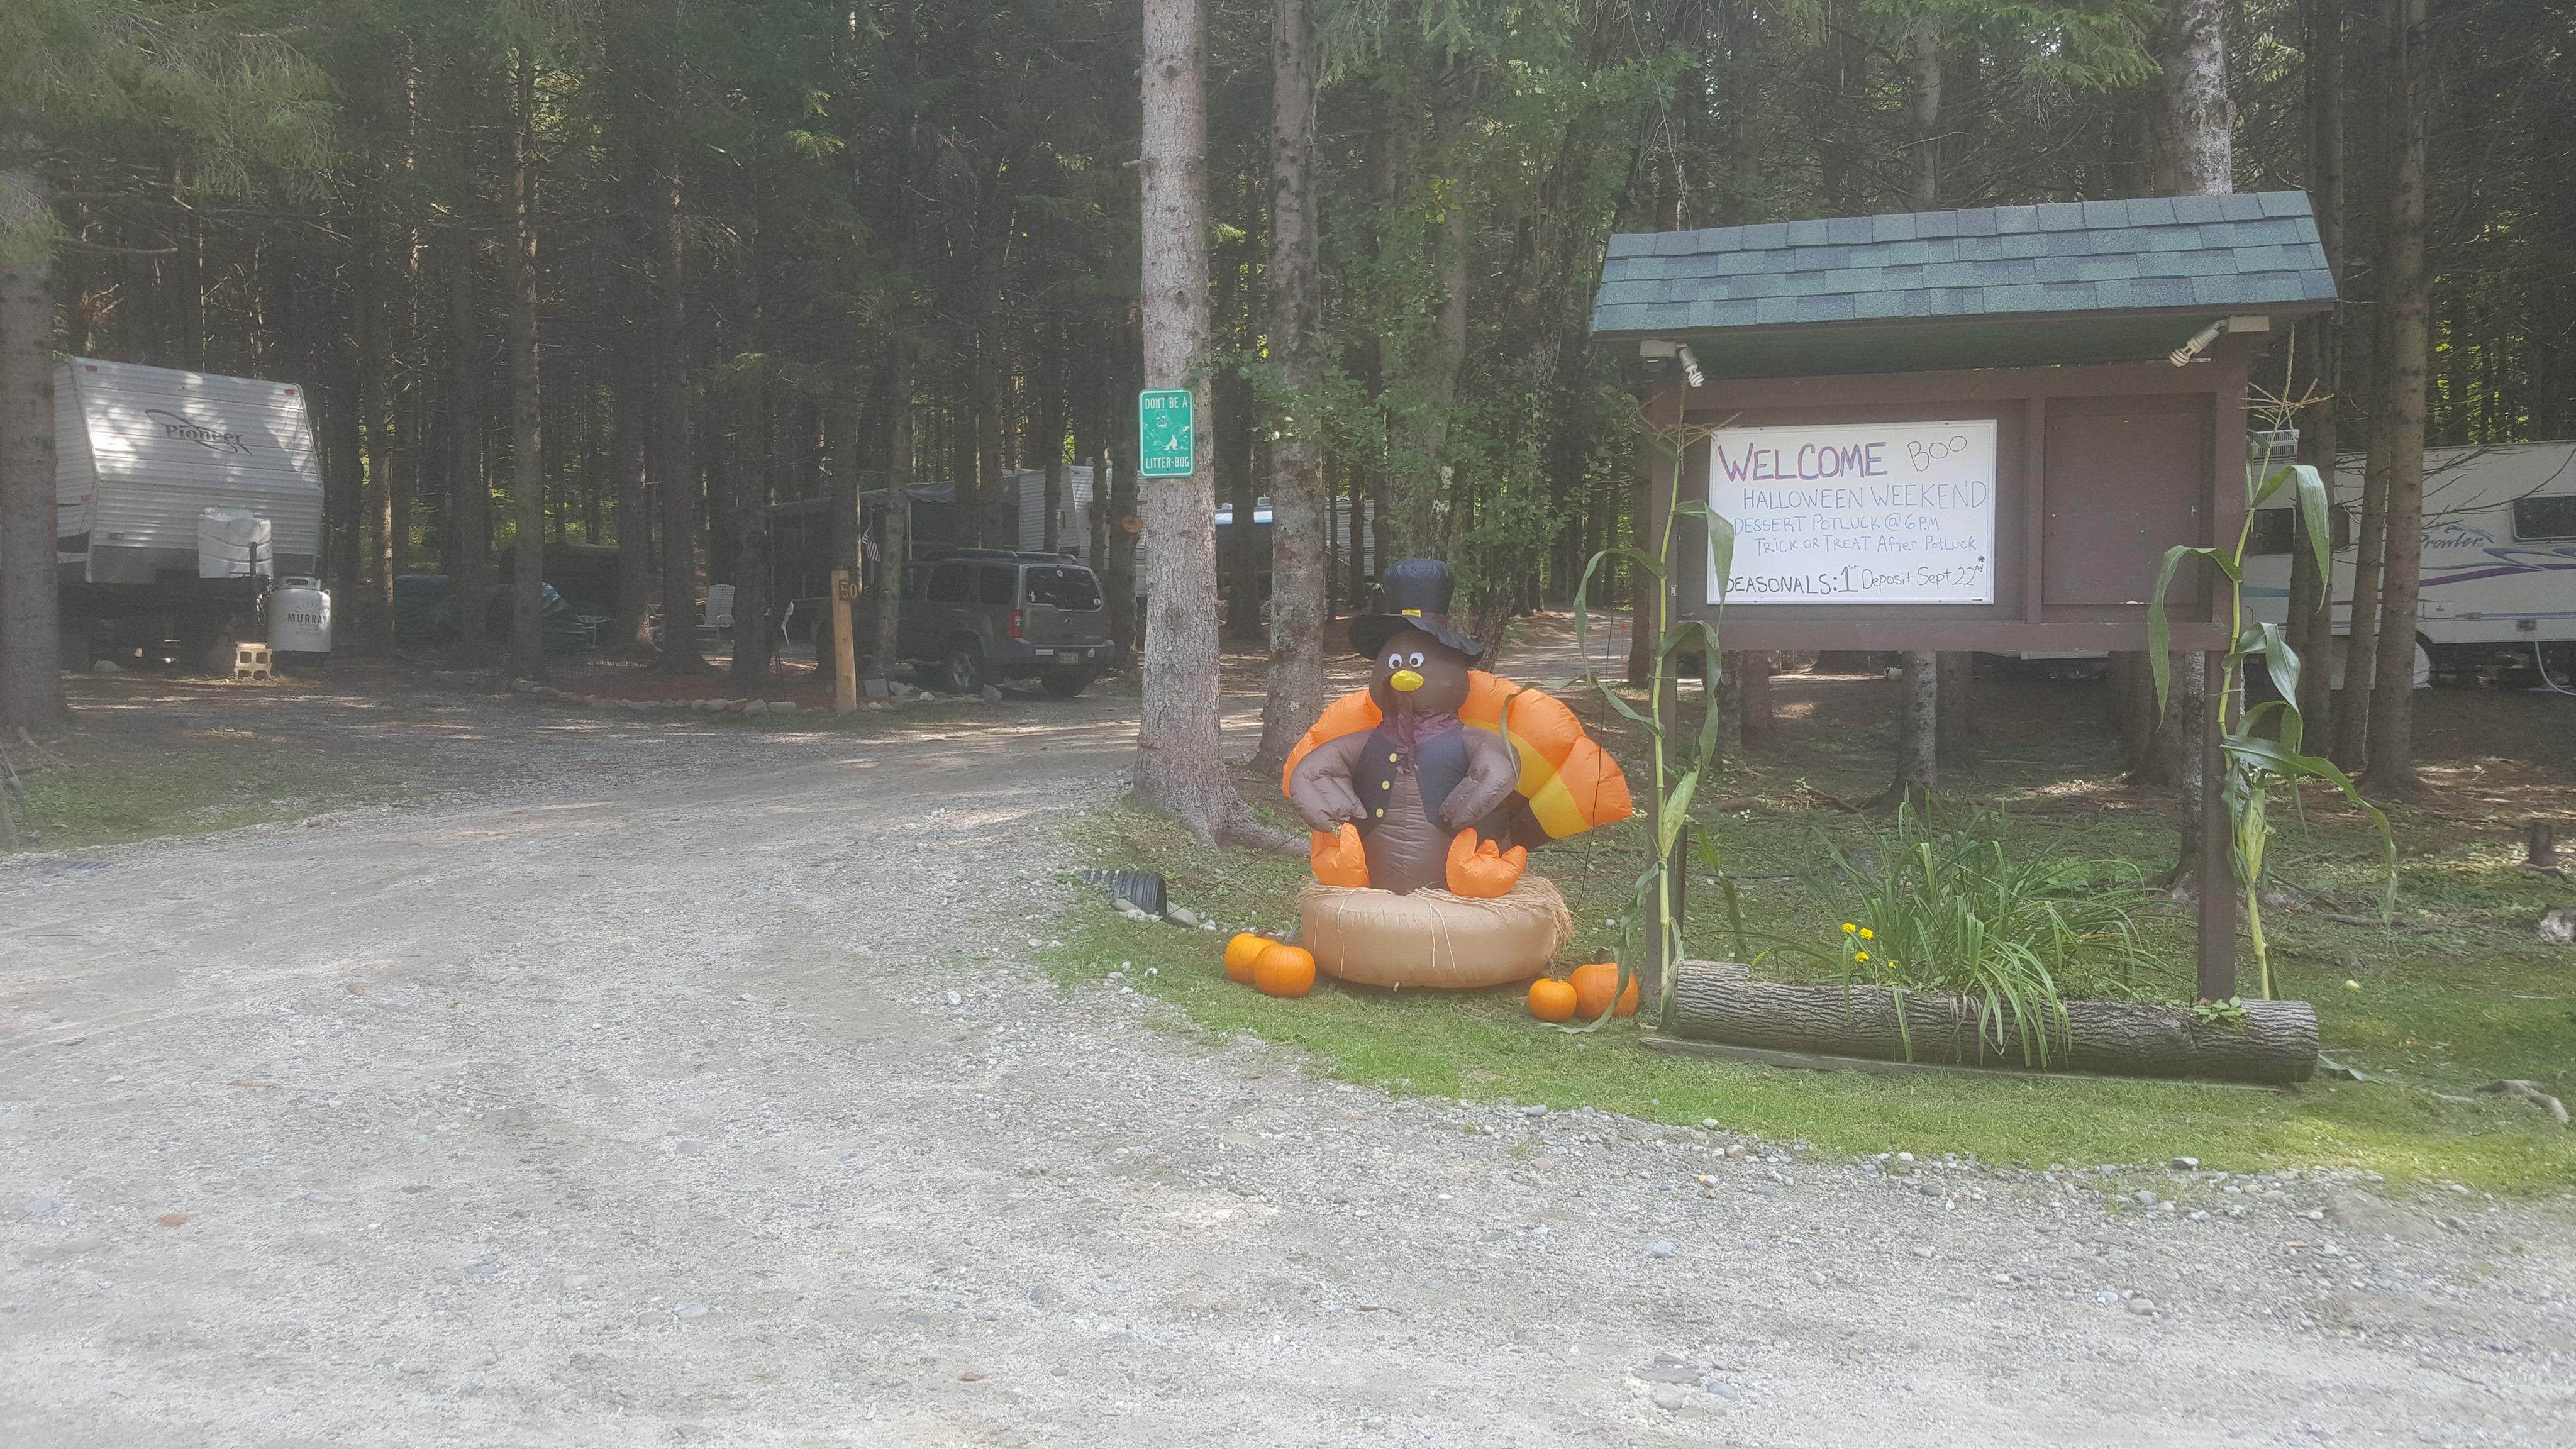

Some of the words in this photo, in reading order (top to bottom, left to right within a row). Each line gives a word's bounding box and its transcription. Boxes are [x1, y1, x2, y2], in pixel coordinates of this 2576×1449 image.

[1169, 397, 1179, 409] BE
[1182, 397, 1188, 408] A
[165, 423, 243, 444] Pioneer
[1146, 456, 1190, 469] LITTER-BUG
[1718, 442, 1888, 482] WELCOME
[1743, 487, 1863, 510] HALLOWEEN
[1870, 480, 1987, 511] WEEKEND
[1734, 516, 1806, 536] DESSERT
[1803, 538, 1819, 549] OR
[1823, 535, 1872, 552] TREAT
[1877, 535, 1918, 552] After
[1862, 569, 1913, 593] Deposit
[1917, 567, 1952, 589] Sept
[841, 582, 858, 599] 50
[287, 613, 327, 625] MURRAY
